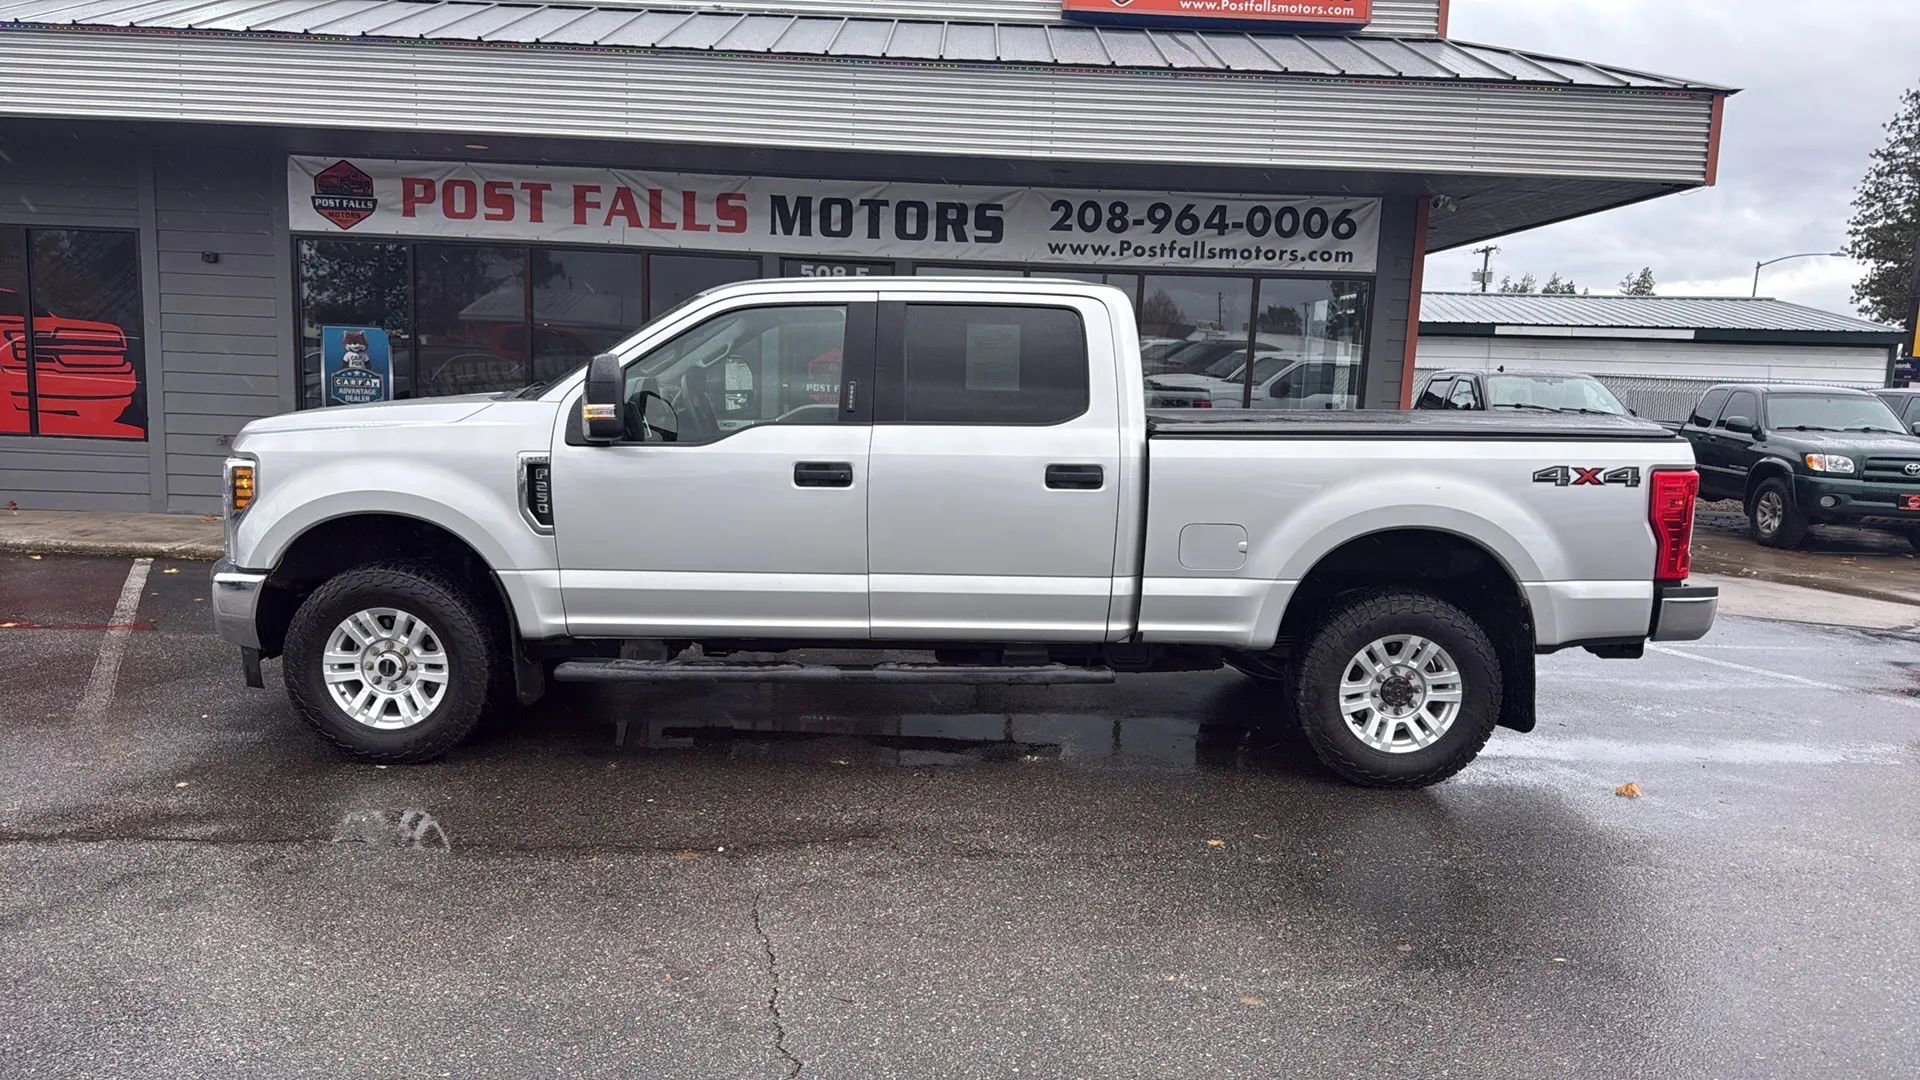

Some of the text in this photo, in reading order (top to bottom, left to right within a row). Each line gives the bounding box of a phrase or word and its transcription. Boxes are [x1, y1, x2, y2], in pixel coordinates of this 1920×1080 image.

[1180, 0, 1355, 16] www.Postfallsmotors.com
[315, 198, 373, 209] POST FALLS
[401, 177, 1004, 244] POST FALLS MOTORS
[1049, 199, 1357, 240] 208-964-0006
[1047, 240, 1354, 263] www.Postfallsmotors.com
[338, 387, 376, 396] ADVANTAGE
